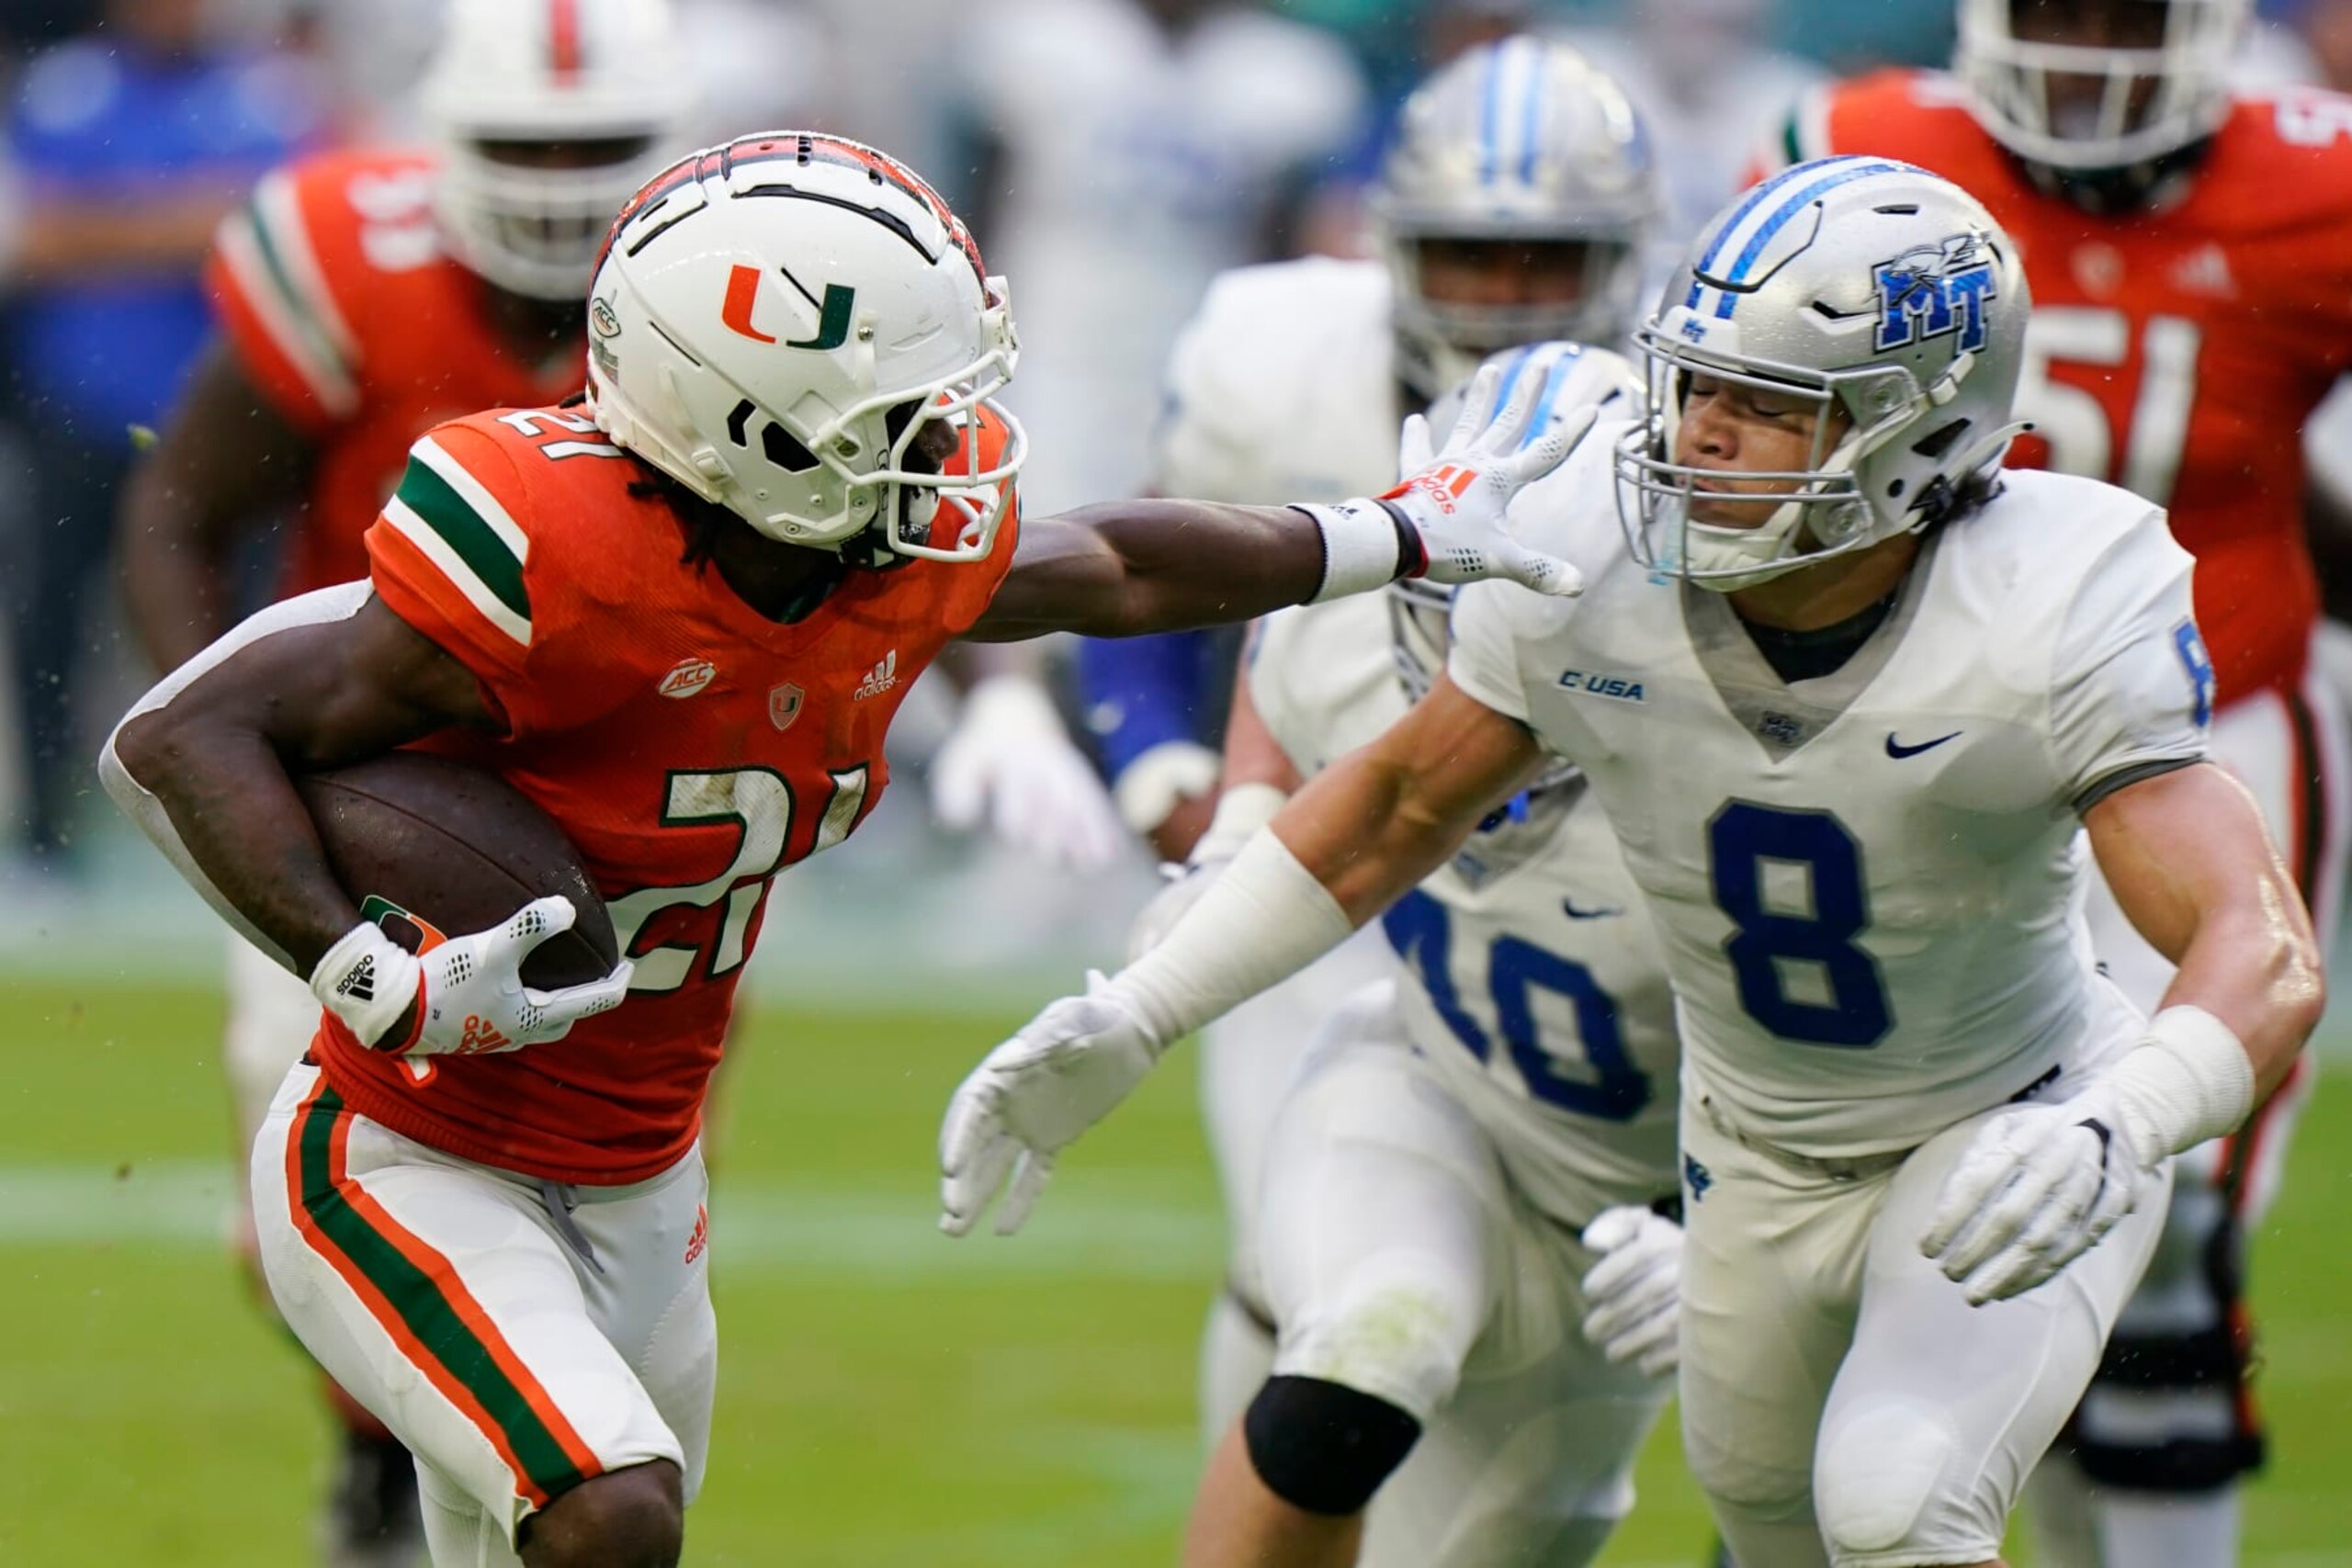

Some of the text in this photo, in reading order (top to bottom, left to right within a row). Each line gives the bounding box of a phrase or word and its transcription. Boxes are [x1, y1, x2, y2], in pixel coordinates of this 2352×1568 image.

[595, 306, 618, 330] ACC
[722, 264, 855, 351] U
[2006, 305, 2205, 510] 51
[670, 667, 712, 689] ACC
[597, 761, 871, 994] 21
[1704, 795, 1898, 1051] 8
[336, 953, 374, 996] adidas
